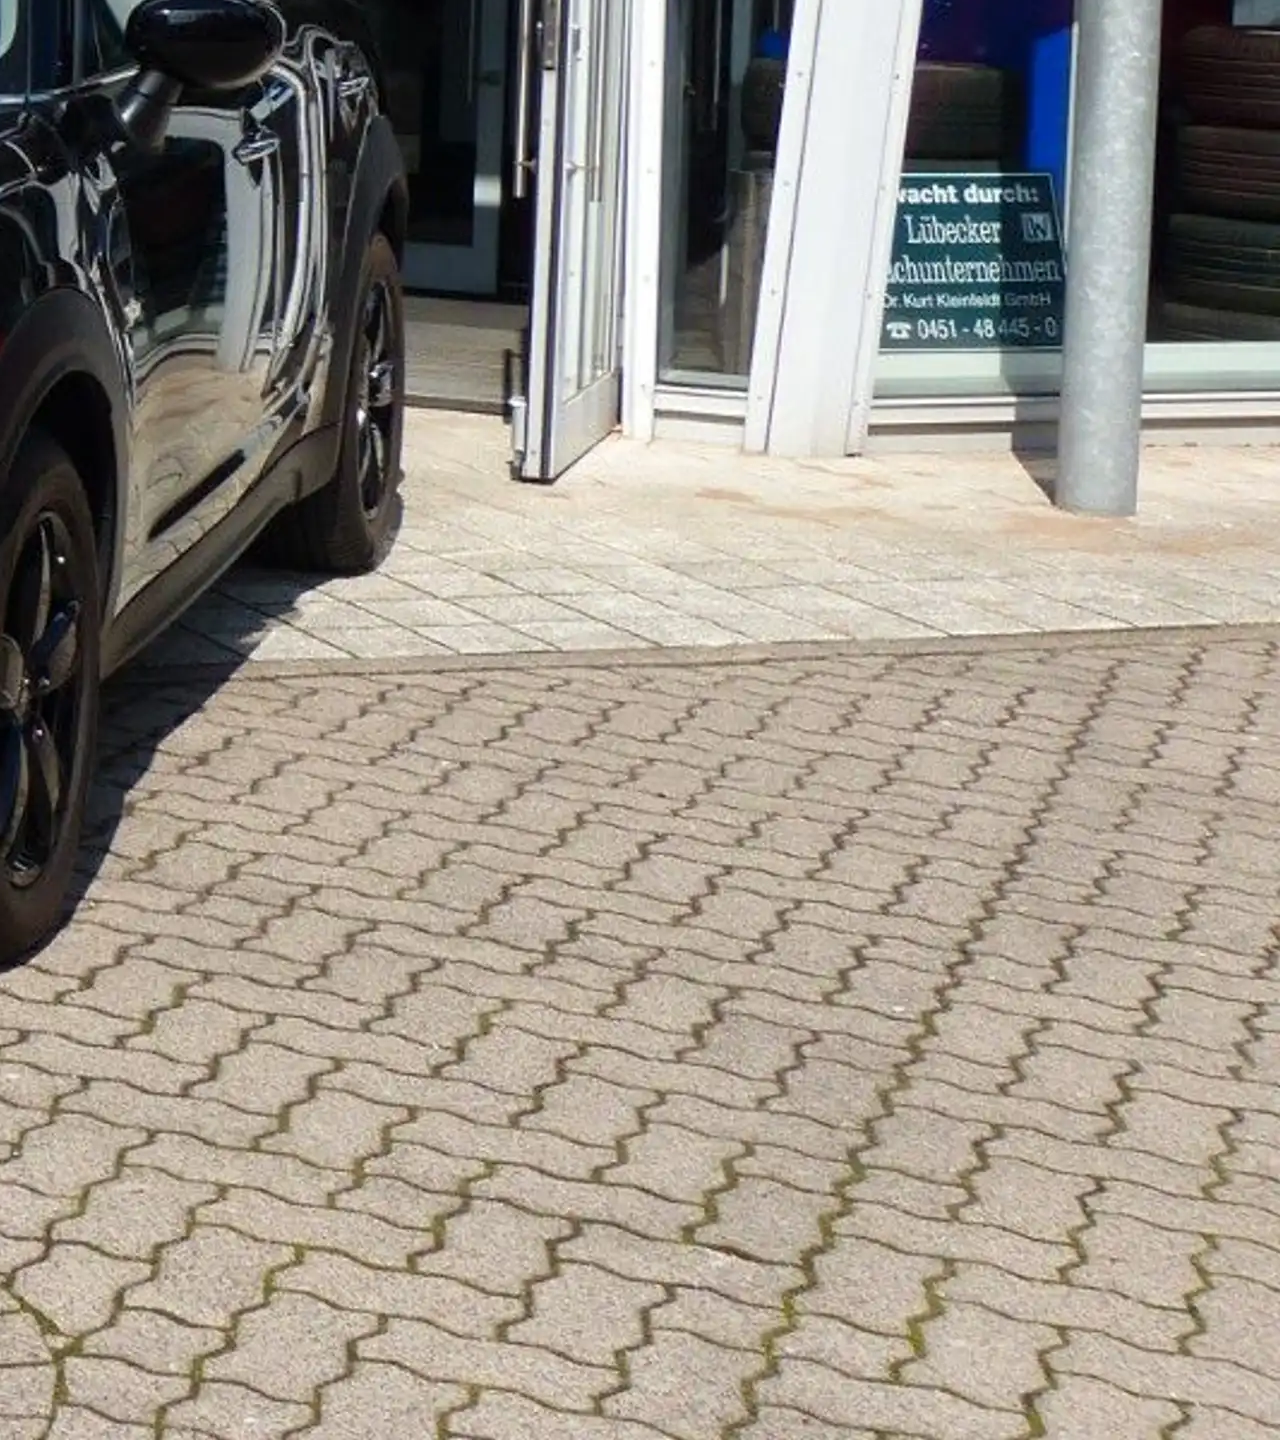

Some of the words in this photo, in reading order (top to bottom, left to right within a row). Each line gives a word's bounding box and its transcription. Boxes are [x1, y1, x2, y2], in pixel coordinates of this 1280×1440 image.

[964, 184, 1038, 204] durch:
[904, 215, 1001, 244] Lübecker
[886, 254, 1063, 283] chunternehmen
[903, 293, 933, 309] Kurt
[1004, 292, 1051, 308] GmbH
[917, 319, 957, 339] 0451
